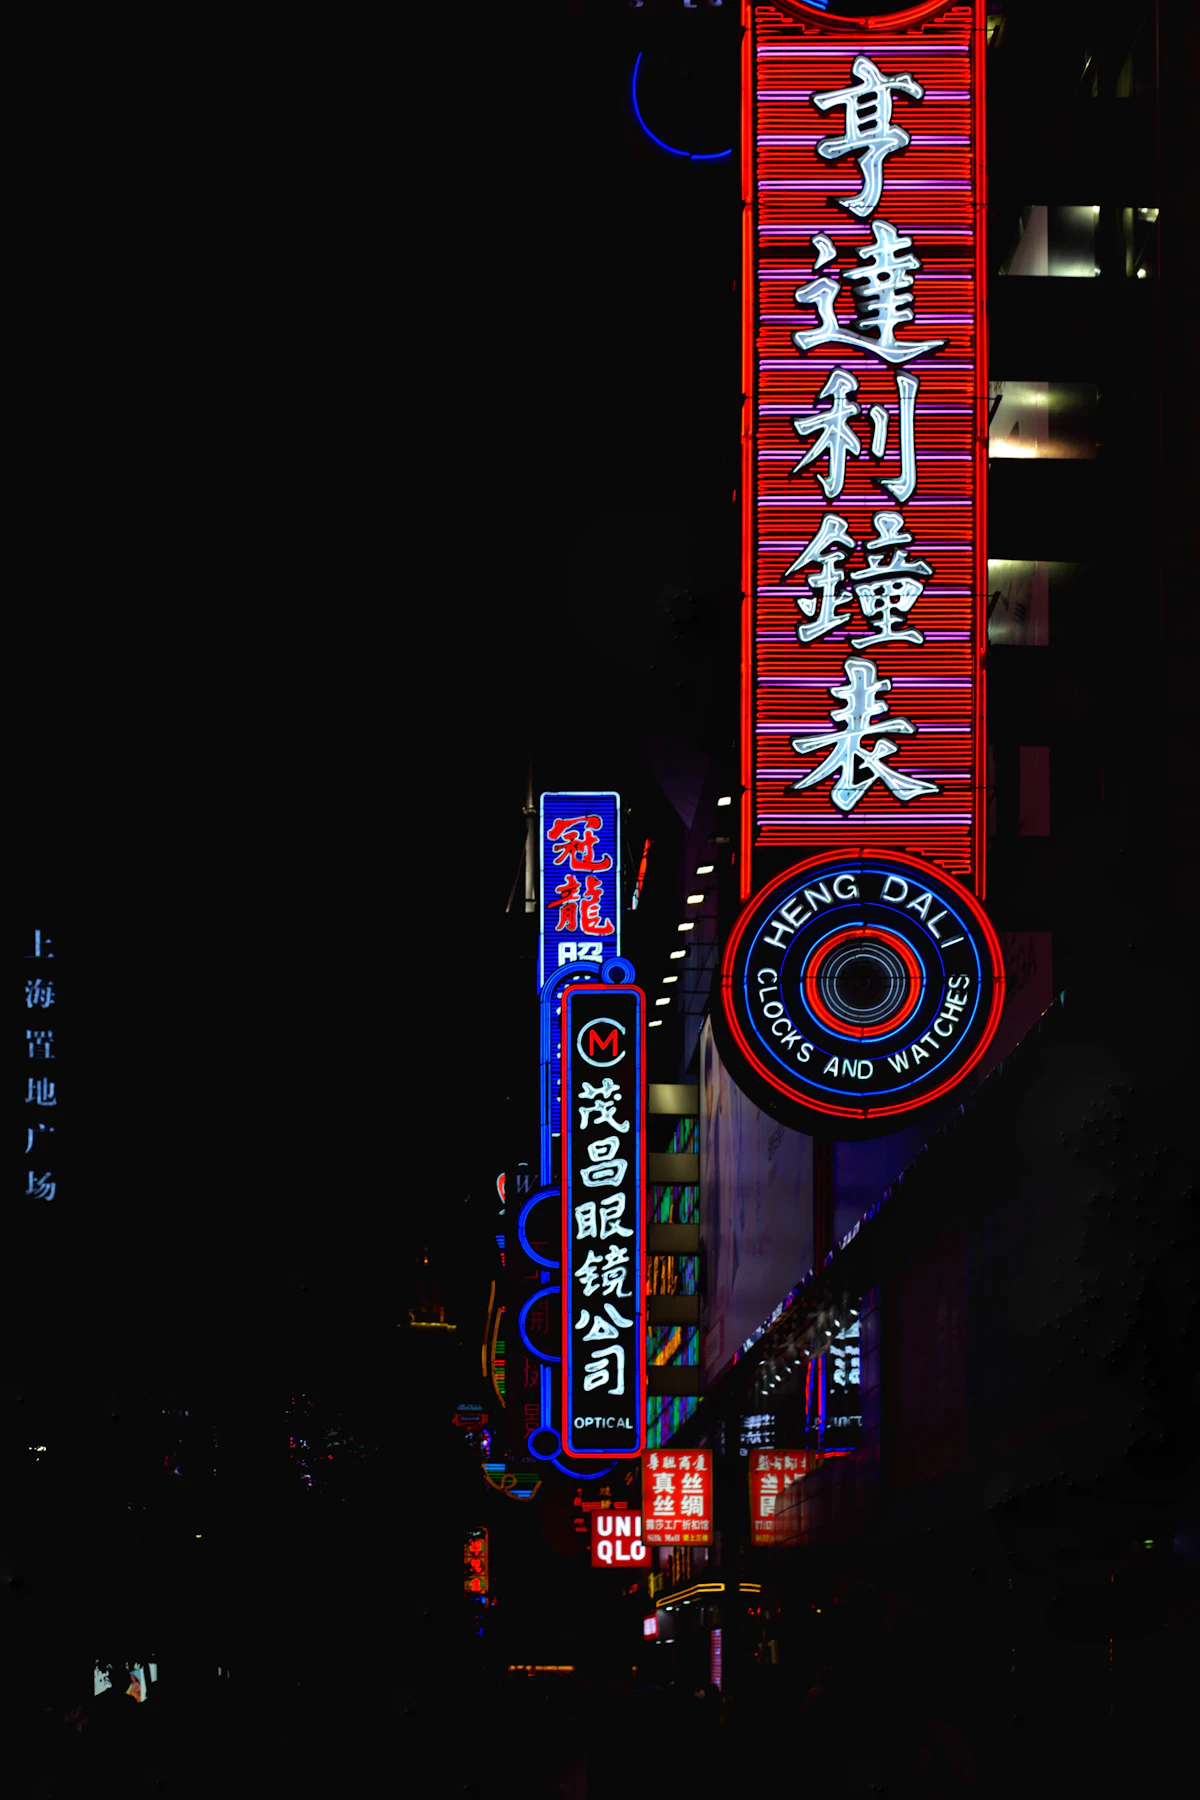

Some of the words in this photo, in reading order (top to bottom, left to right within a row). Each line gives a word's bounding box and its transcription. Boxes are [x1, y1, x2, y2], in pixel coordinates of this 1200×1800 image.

[763, 874, 860, 949] HENG
[880, 875, 964, 948] DALI
[757, 967, 814, 1063] CLOCKS
[823, 1056, 874, 1080] AND
[887, 973, 970, 1074] WATCHES
[24, 928, 57, 1202] 上海置地广场
[573, 1077, 635, 1396] 茂昌眼镜公司
[573, 1416, 634, 1430] OPTICAL
[652, 1472, 704, 1494] 真丝
[652, 1494, 704, 1517] 丝绸
[596, 1515, 642, 1537] UNI
[596, 1539, 647, 1564] QLO
